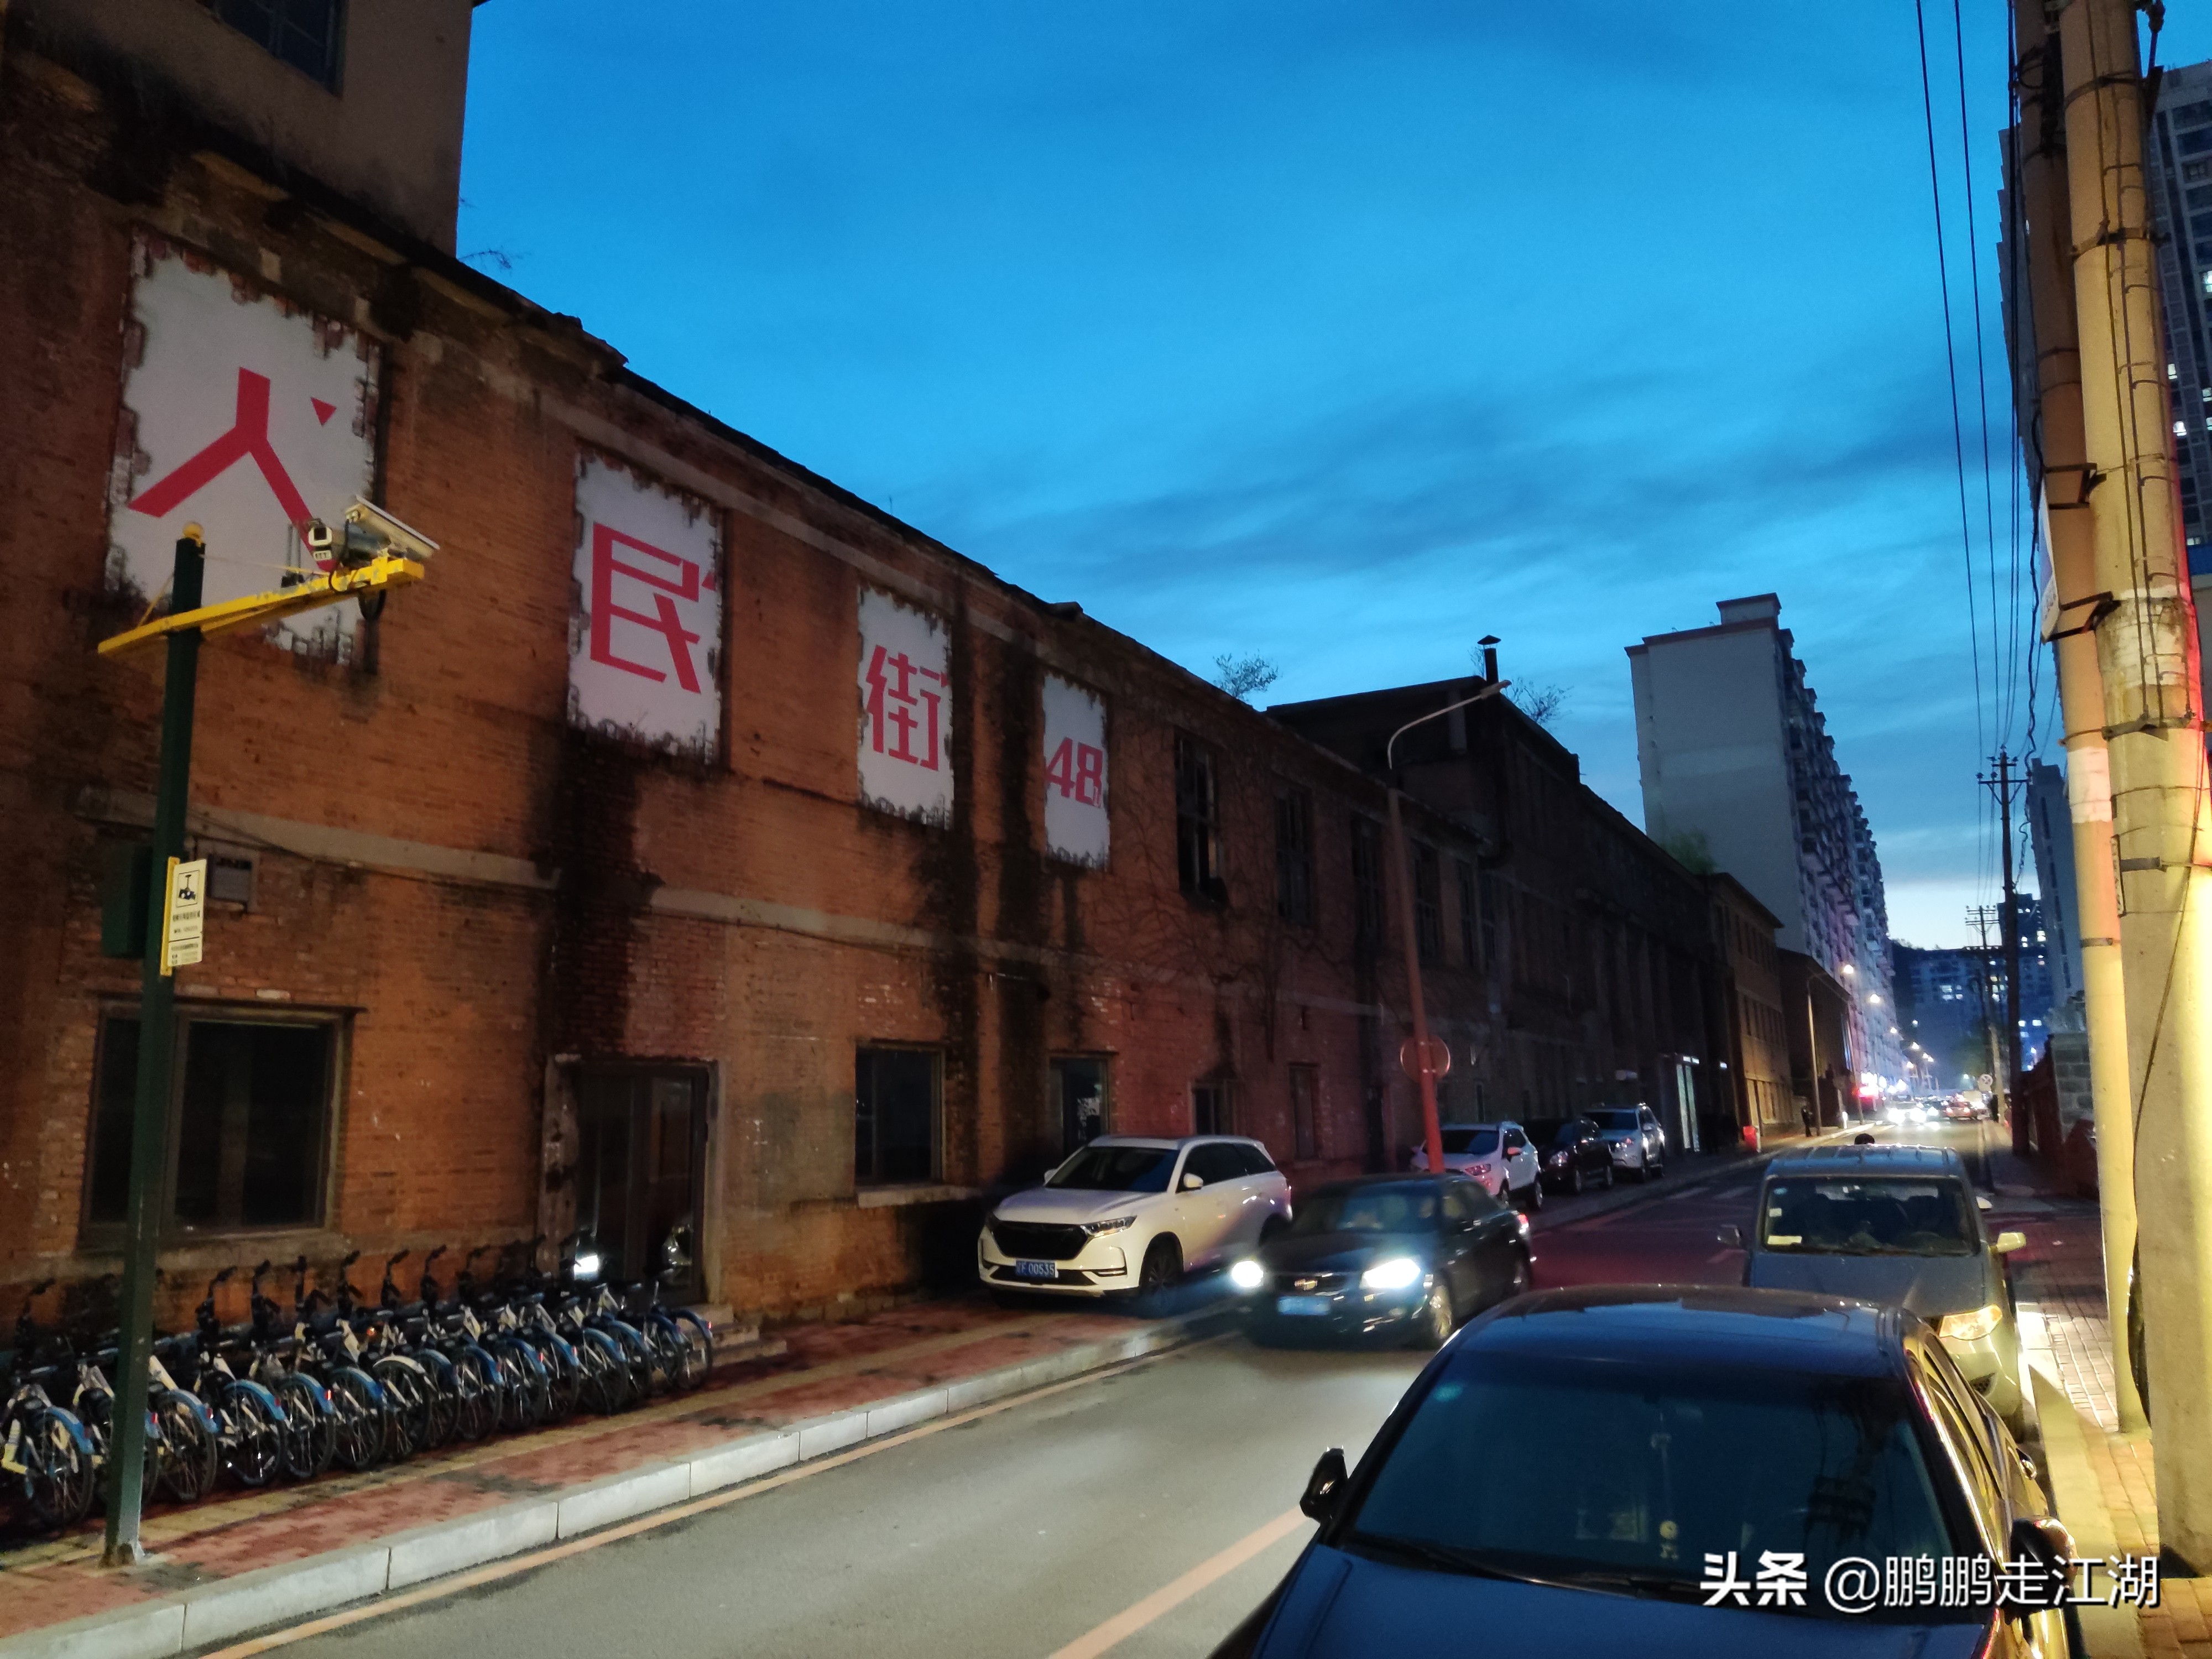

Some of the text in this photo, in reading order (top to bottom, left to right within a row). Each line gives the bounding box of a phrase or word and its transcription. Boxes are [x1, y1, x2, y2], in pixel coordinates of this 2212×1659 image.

[590, 522, 701, 693] 民
[866, 645, 942, 770] 街
[1045, 737, 1103, 808] 48
